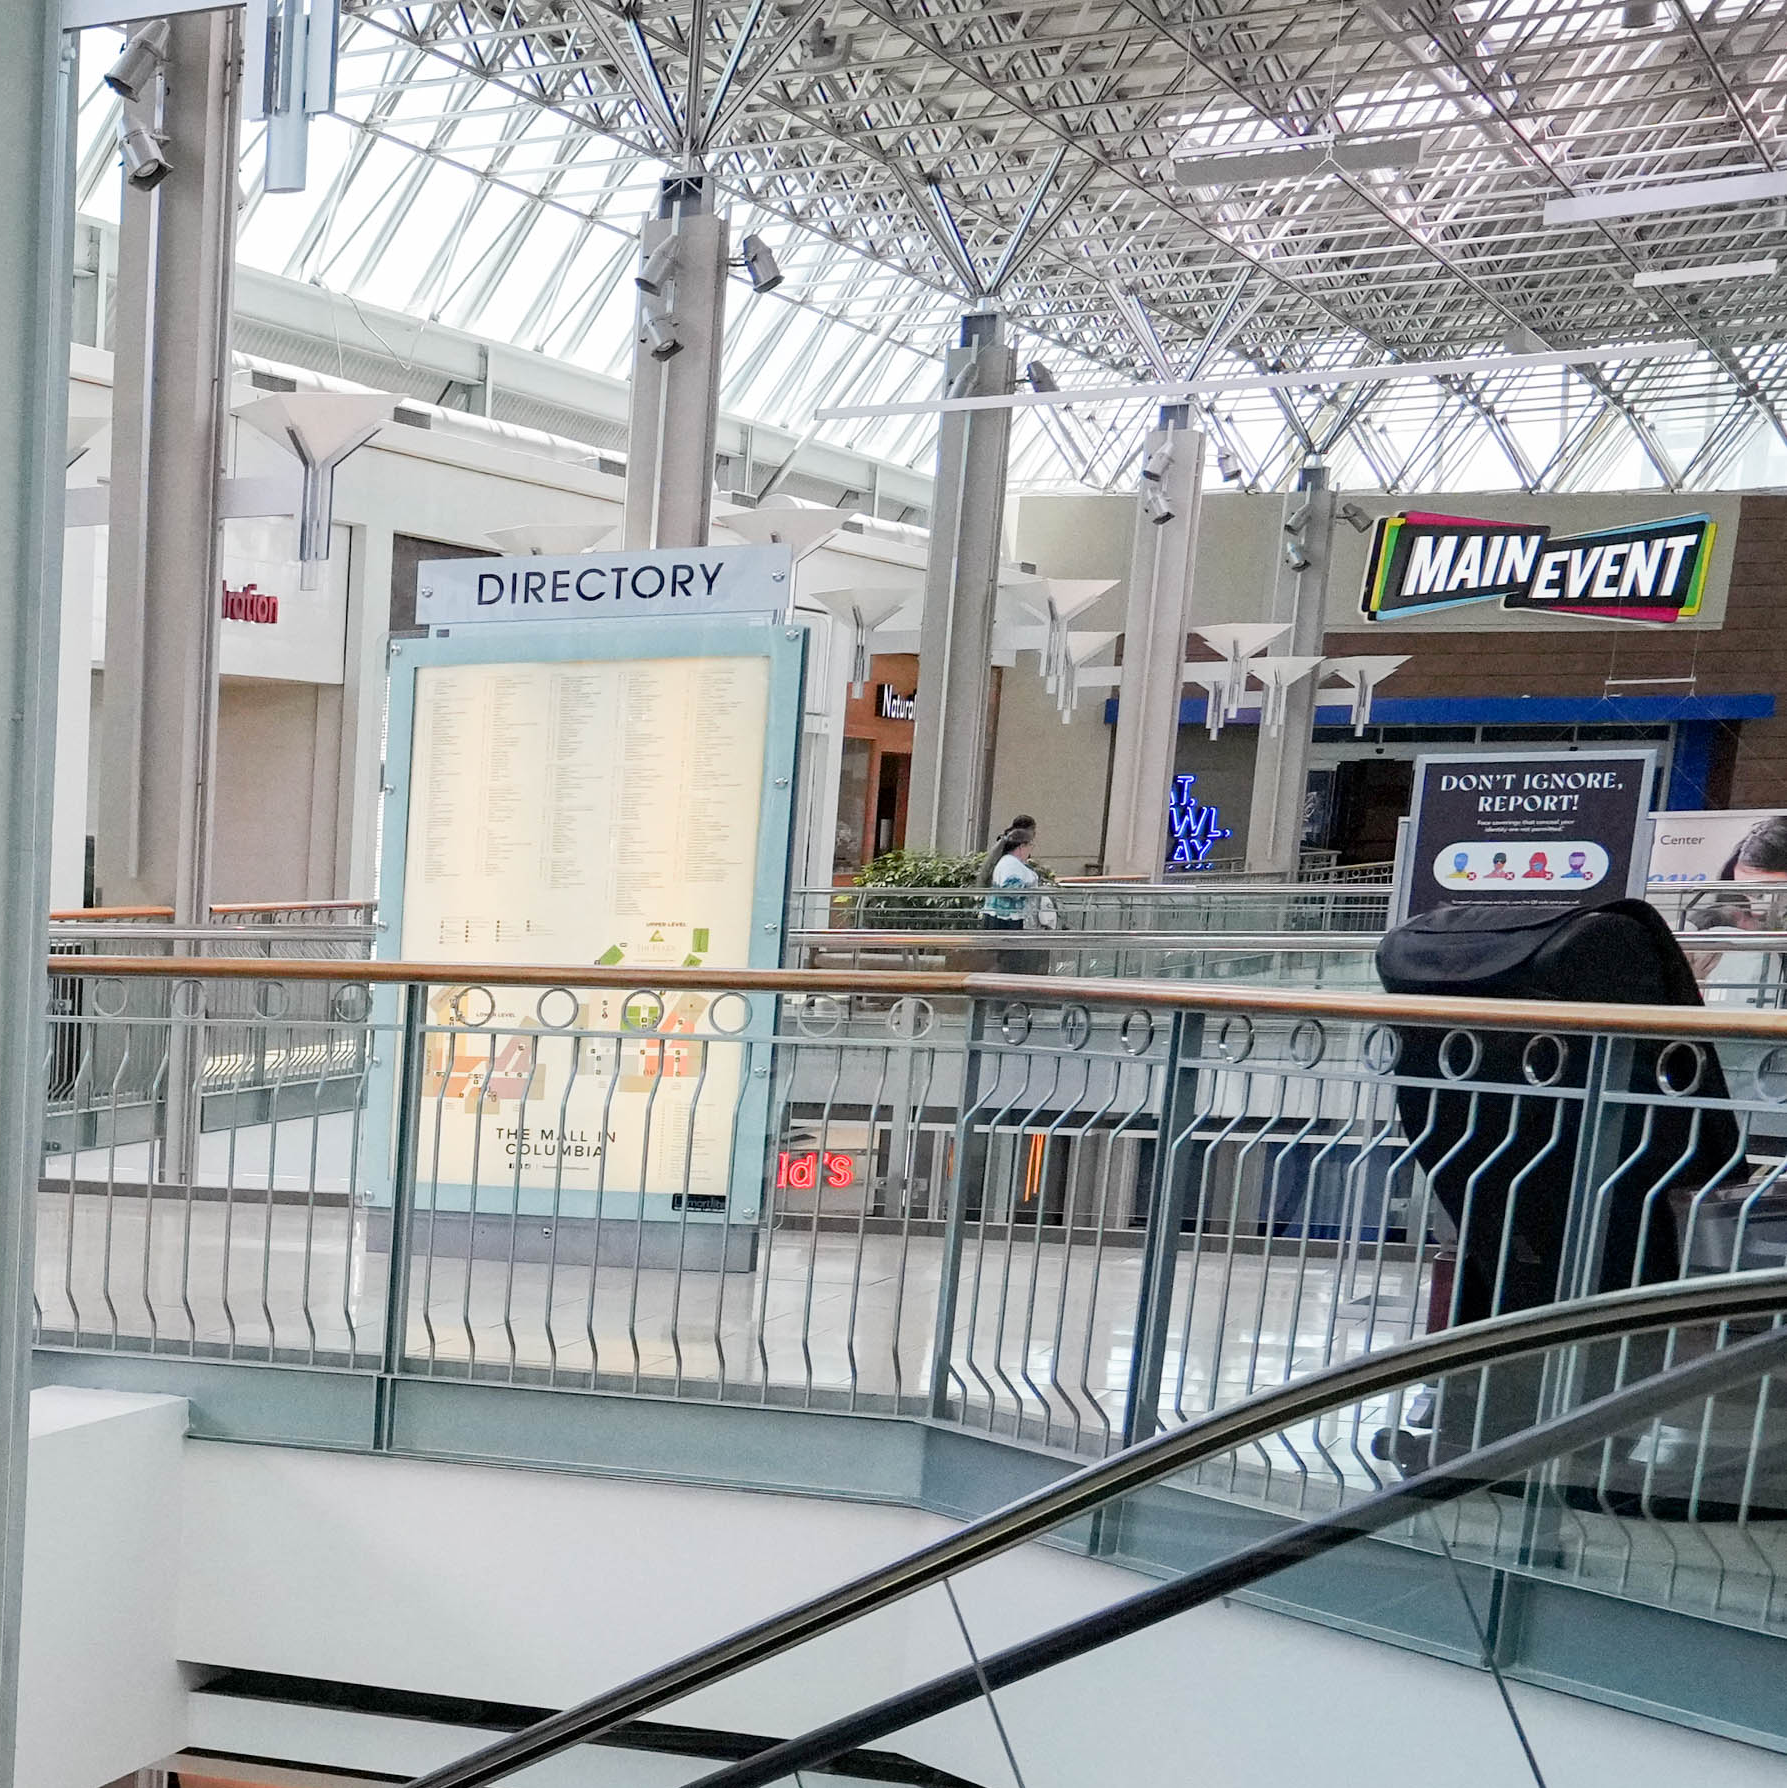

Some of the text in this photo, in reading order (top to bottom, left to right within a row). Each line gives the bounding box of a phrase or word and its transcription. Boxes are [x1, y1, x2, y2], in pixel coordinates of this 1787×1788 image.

[1400, 534, 1699, 599] MAIN EVENT
[477, 562, 724, 606] DIRECTORY
[882, 683, 917, 720] Natural
[1440, 771, 1624, 792] DON'T IGNORE,
[1477, 794, 1580, 813] REPORT!
[1660, 834, 1706, 846] Center
[496, 1128, 616, 1143] THE MALL IN
[505, 1143, 604, 1157] COLUMBIA
